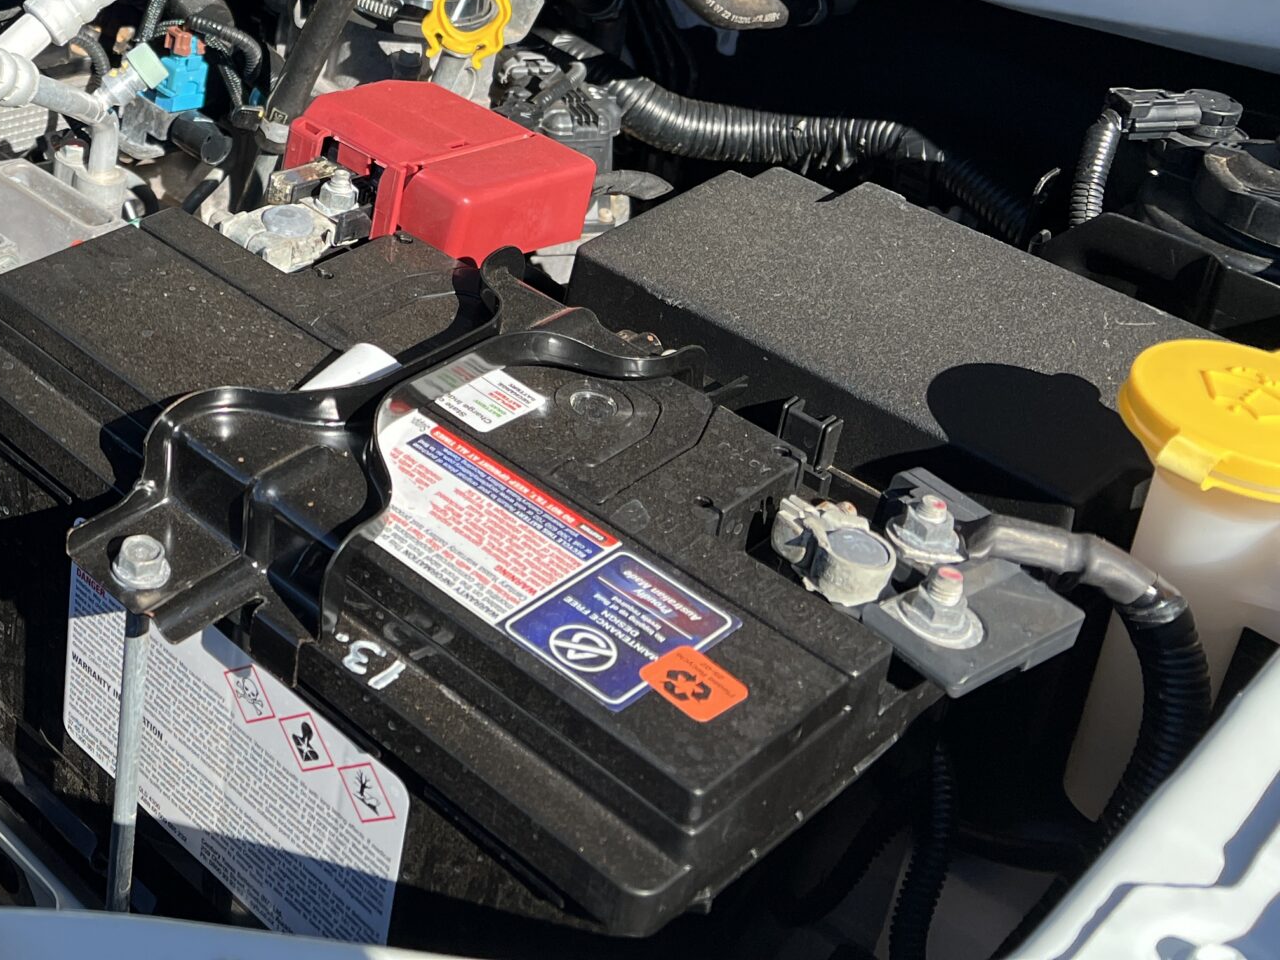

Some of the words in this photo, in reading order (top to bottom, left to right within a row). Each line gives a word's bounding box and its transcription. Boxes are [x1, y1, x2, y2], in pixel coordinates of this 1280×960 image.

[444, 401, 467, 417] State
[461, 402, 492, 425] Charge
[432, 429, 457, 446] TIMES
[454, 444, 471, 455] ALL
[466, 452, 481, 461] AT
[476, 458, 511, 481] UPRIGHT
[507, 478, 531, 494] KEEP
[544, 502, 565, 516] NOT
[560, 512, 577, 523] DO
[399, 549, 457, 587] INFORMATION
[491, 564, 539, 595] WARNING
[620, 569, 653, 589] Made
[451, 586, 501, 619] WARRANTY
[561, 595, 593, 615] FREE
[629, 586, 675, 614] Proudly
[645, 586, 705, 622] Australian
[597, 609, 643, 637] DESIGN
[71, 650, 110, 693] WARRANTY
